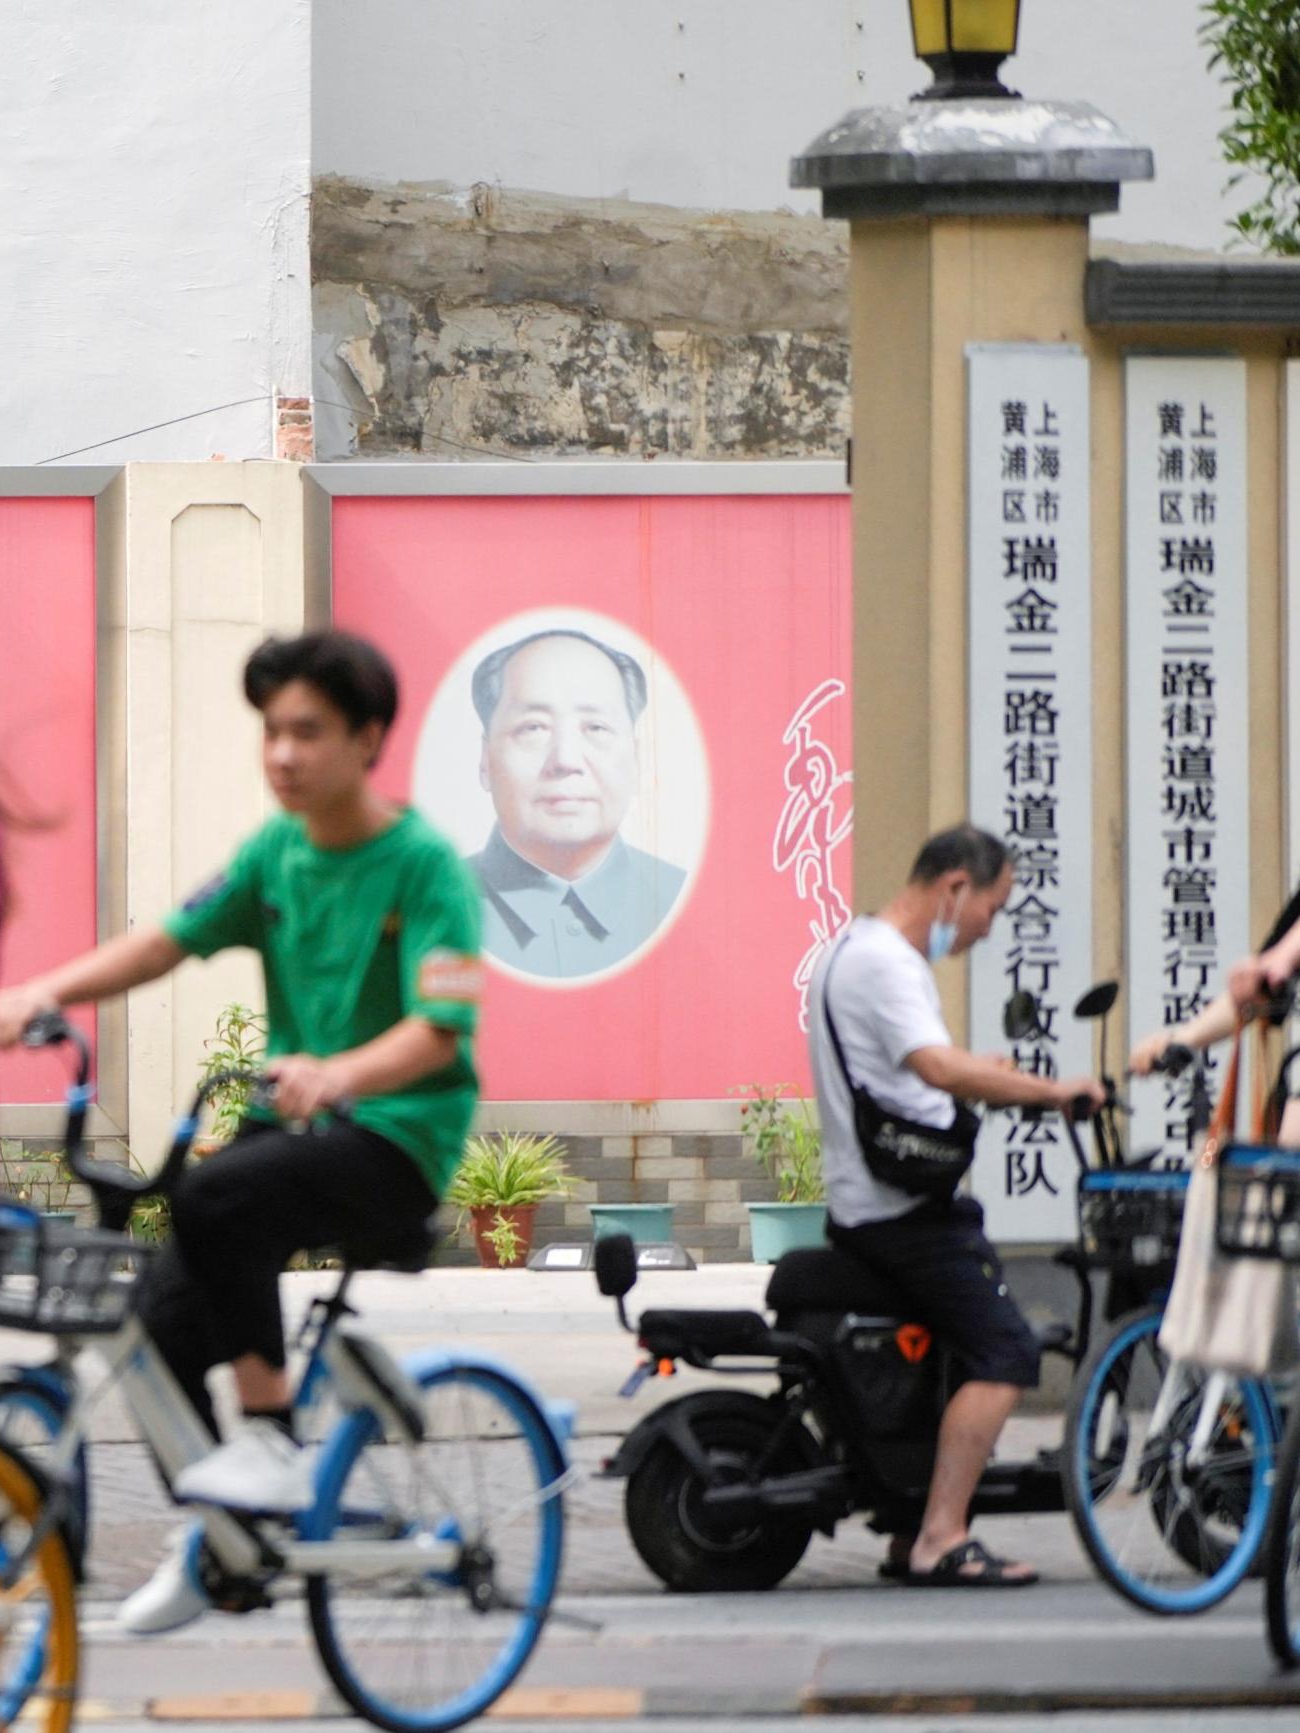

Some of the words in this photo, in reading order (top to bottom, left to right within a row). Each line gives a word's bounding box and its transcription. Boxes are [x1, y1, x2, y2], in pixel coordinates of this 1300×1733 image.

[1002, 399, 1028, 525] 黄浦区
[1034, 399, 1060, 525] 上海市
[1159, 401, 1184, 526] 黄浦区
[1191, 401, 1217, 526] 上海市
[1160, 536, 1217, 1172] 瑞金二路街道城市管理行政中
